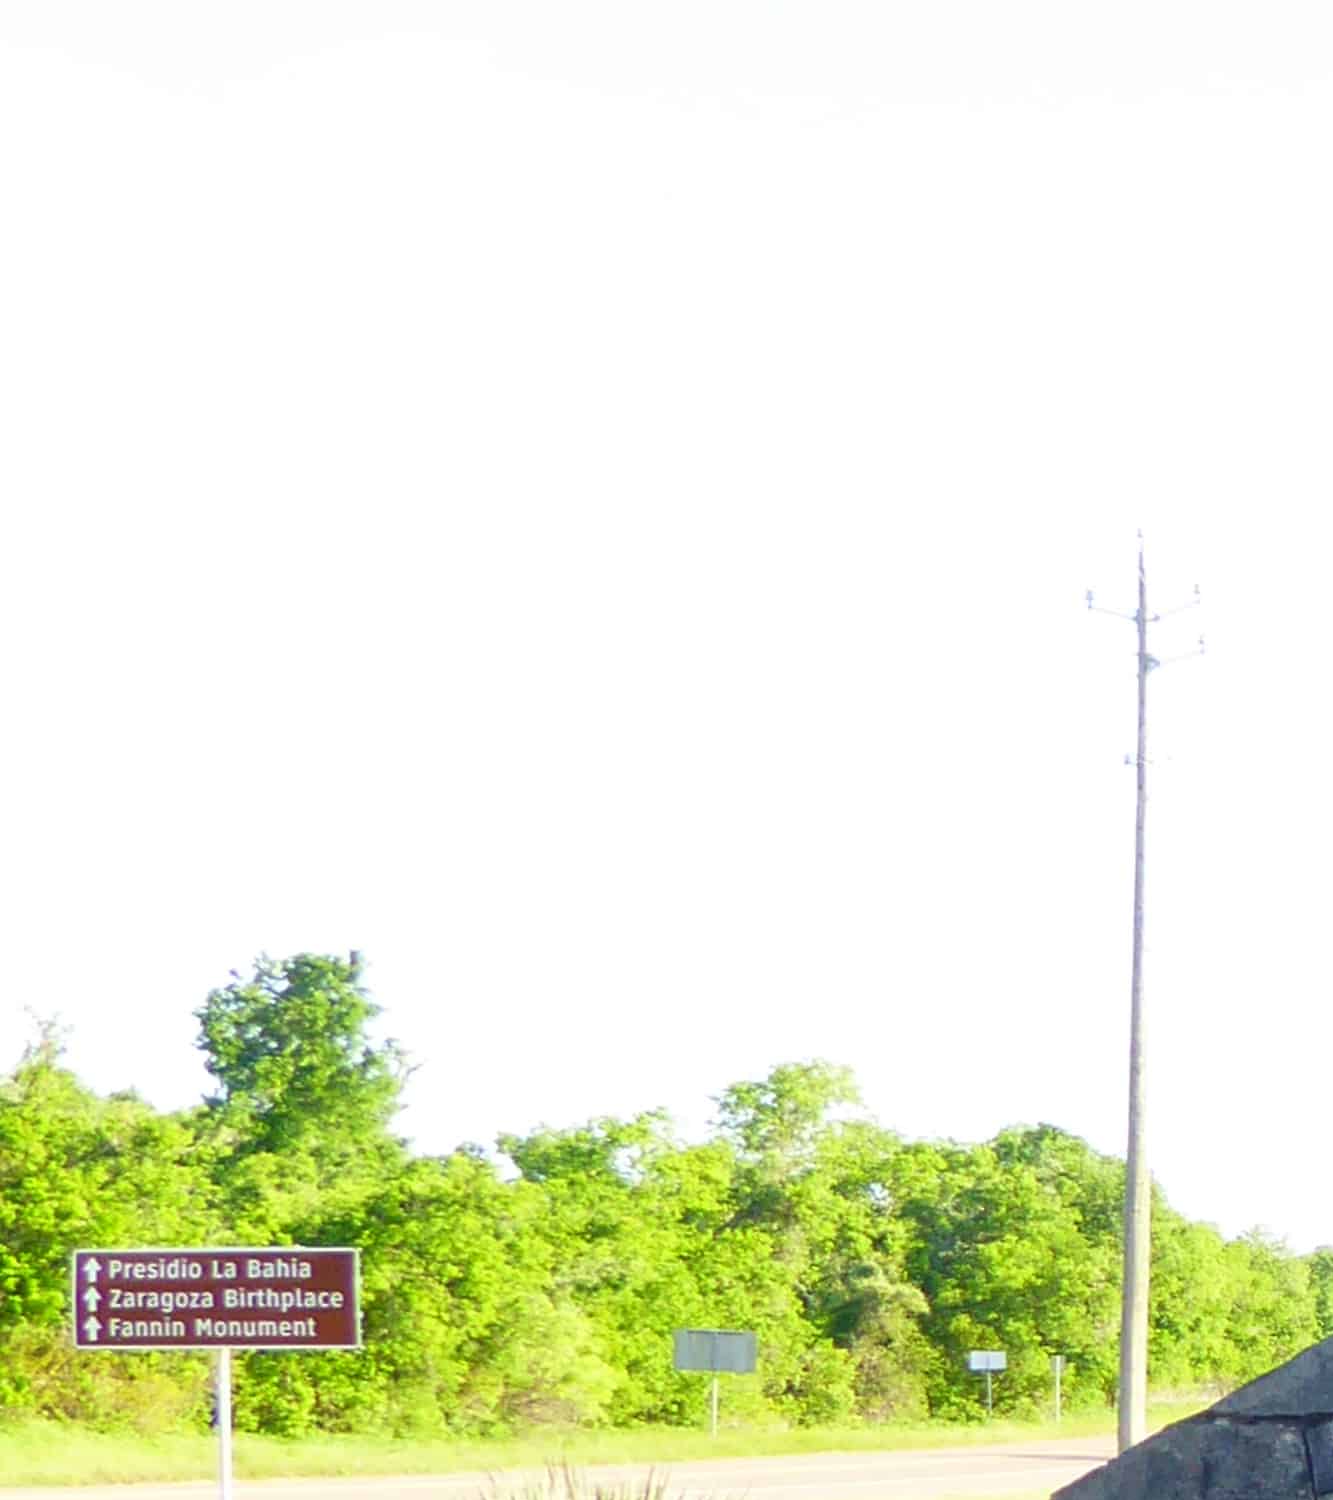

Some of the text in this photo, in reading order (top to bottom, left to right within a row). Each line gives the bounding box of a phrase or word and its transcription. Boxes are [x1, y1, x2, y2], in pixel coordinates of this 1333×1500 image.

[108, 1258, 312, 1280] Presidio La Bahia
[108, 1288, 344, 1312] Zaragoza Birthplace
[108, 1317, 317, 1338] Fannin Monument
